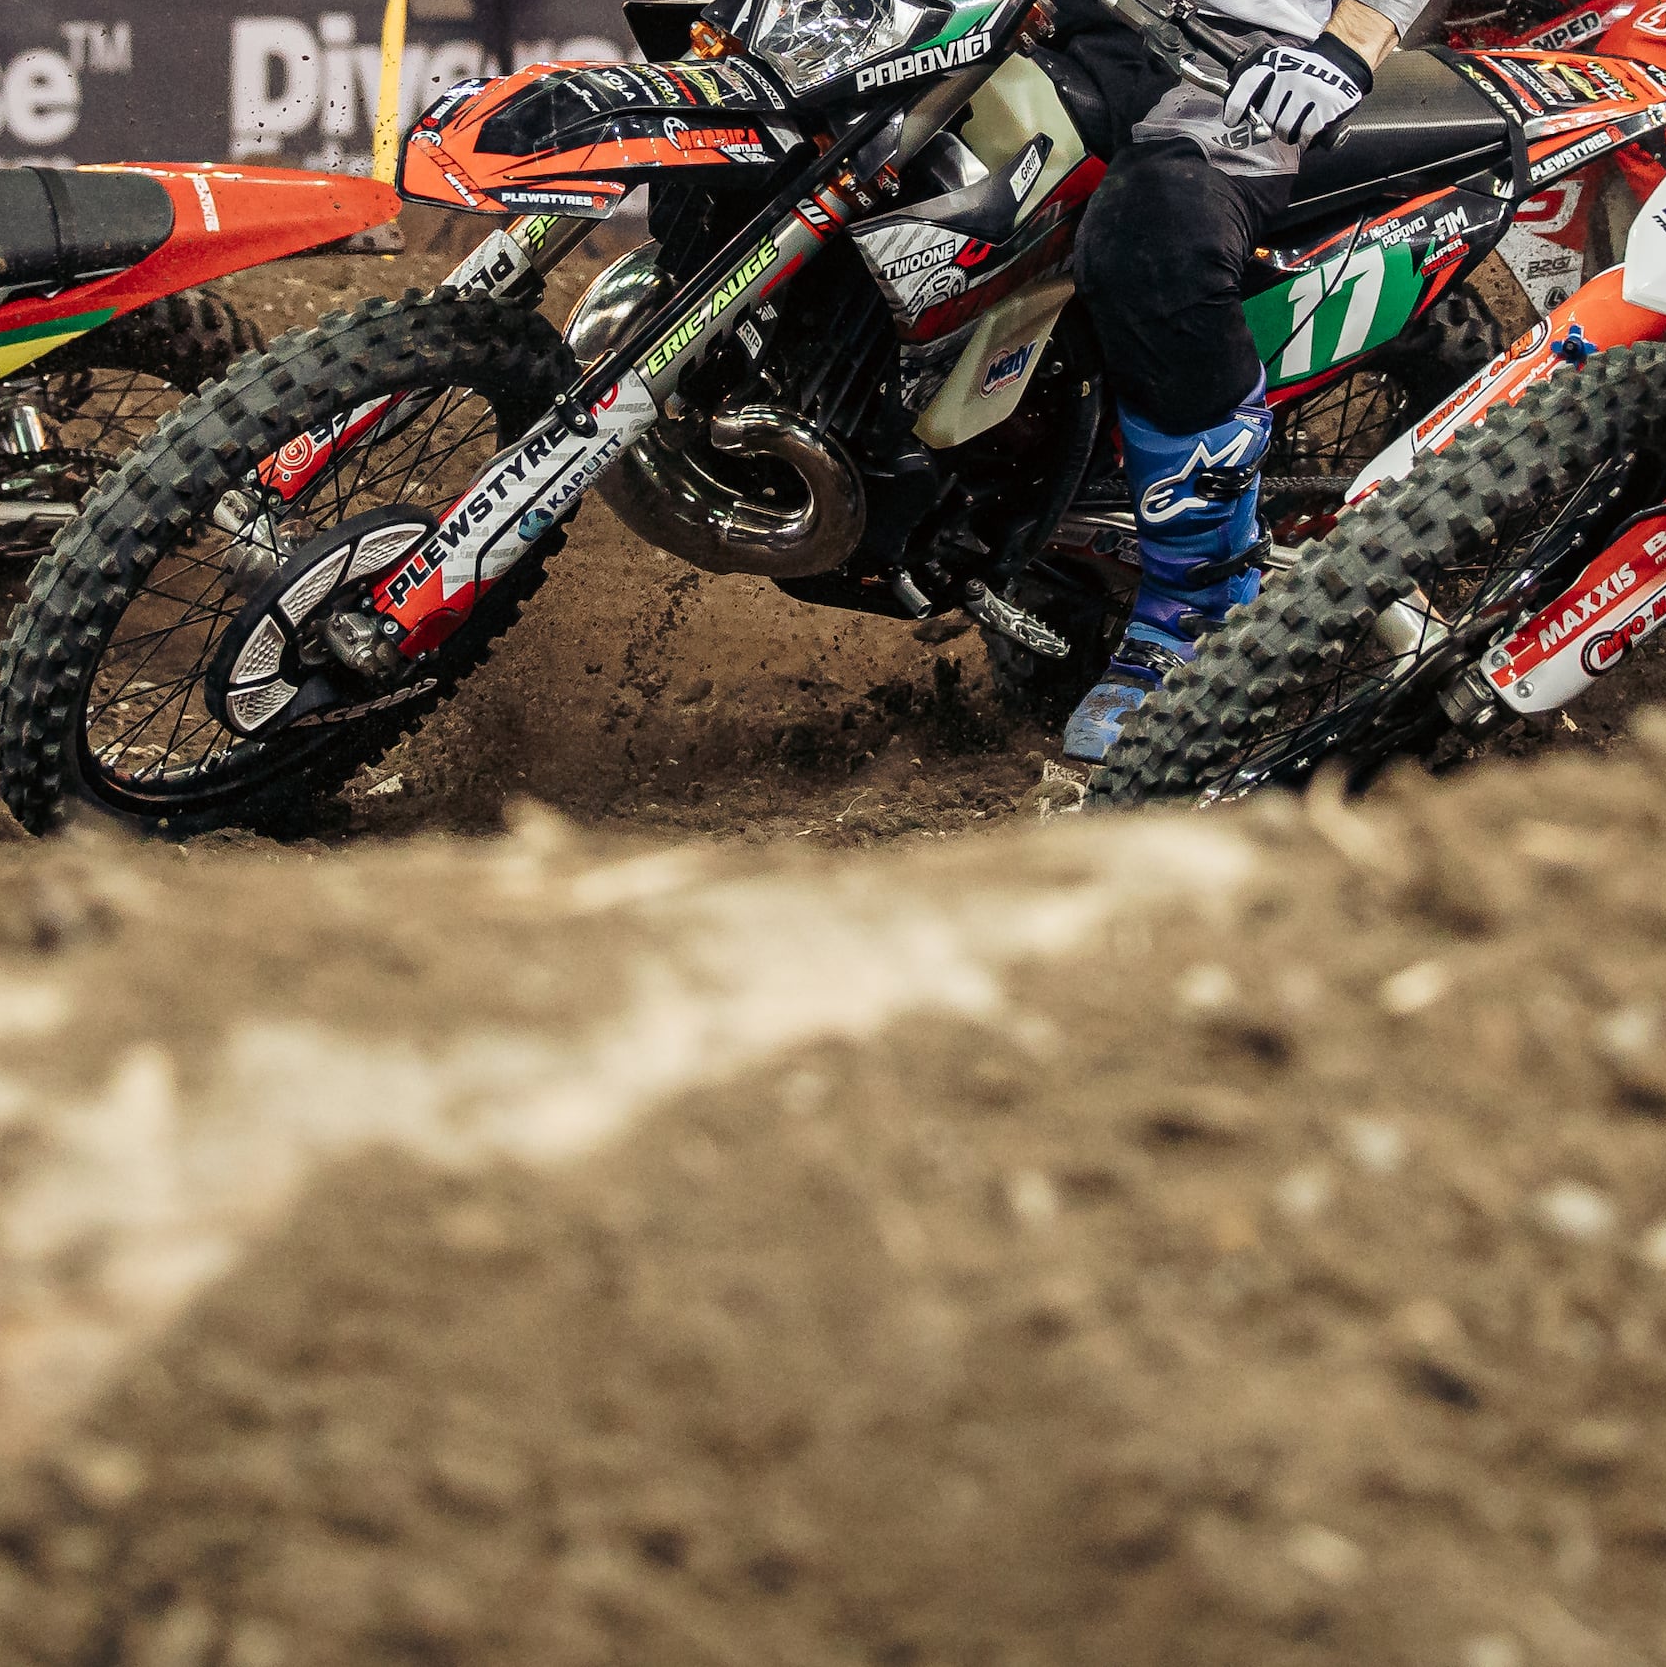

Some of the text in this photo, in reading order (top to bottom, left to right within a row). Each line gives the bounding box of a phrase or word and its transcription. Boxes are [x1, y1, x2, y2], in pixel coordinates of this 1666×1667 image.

[1529, 11, 1601, 51] MPED
[602, 70, 636, 102] VOLA
[1530, 131, 1612, 182] PLEWSTYRES
[501, 192, 593, 208] PLEWSTYRES
[1434, 206, 1469, 241] FIM
[883, 239, 956, 280] TWOONE
[1423, 237, 1464, 266] SUPER
[645, 311, 705, 378] ERIC
[710, 236, 780, 323] AUGÉ
[1279, 244, 1386, 379] 17
[546, 434, 622, 511] KAPUTT
[1539, 563, 1637, 654] MAXXIS
